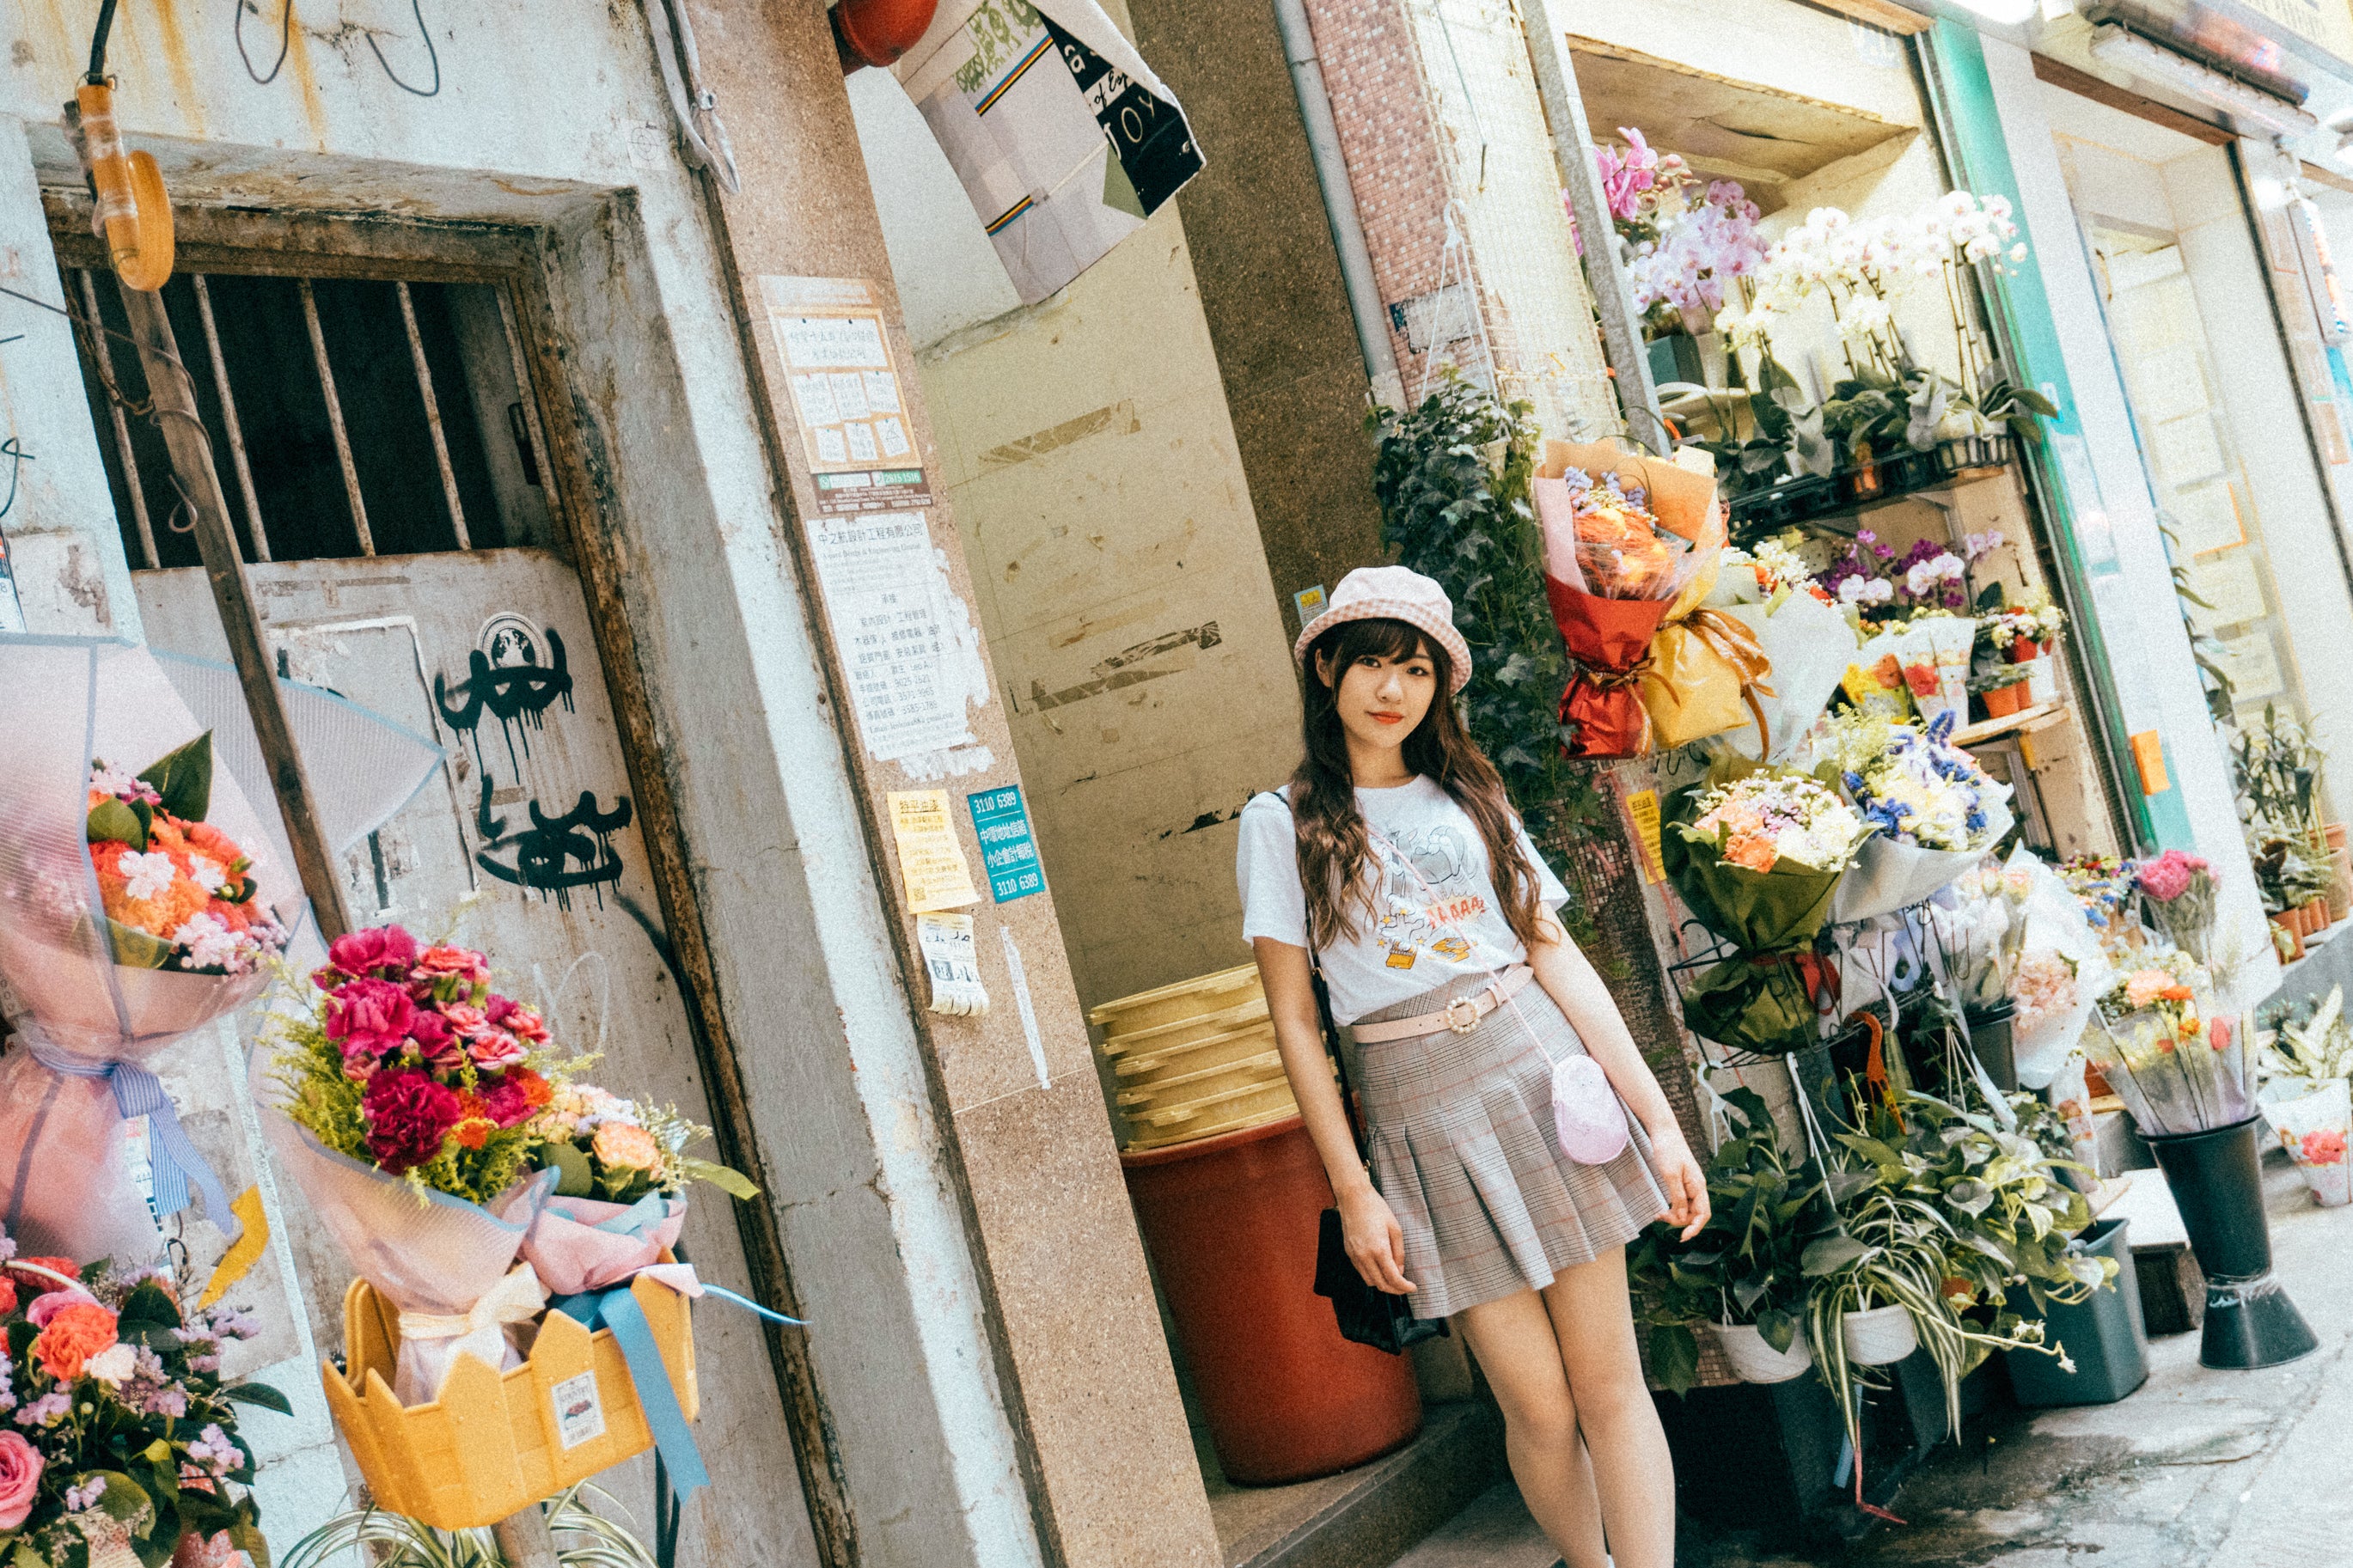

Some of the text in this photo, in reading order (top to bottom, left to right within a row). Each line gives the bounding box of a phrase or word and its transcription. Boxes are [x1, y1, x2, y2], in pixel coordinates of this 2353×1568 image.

[1094, 82, 1107, 108] of
[974, 791, 1017, 814] 3110 6389
[980, 819, 1028, 845] 中環地址信箱
[997, 873, 1039, 896] 3110 6389
